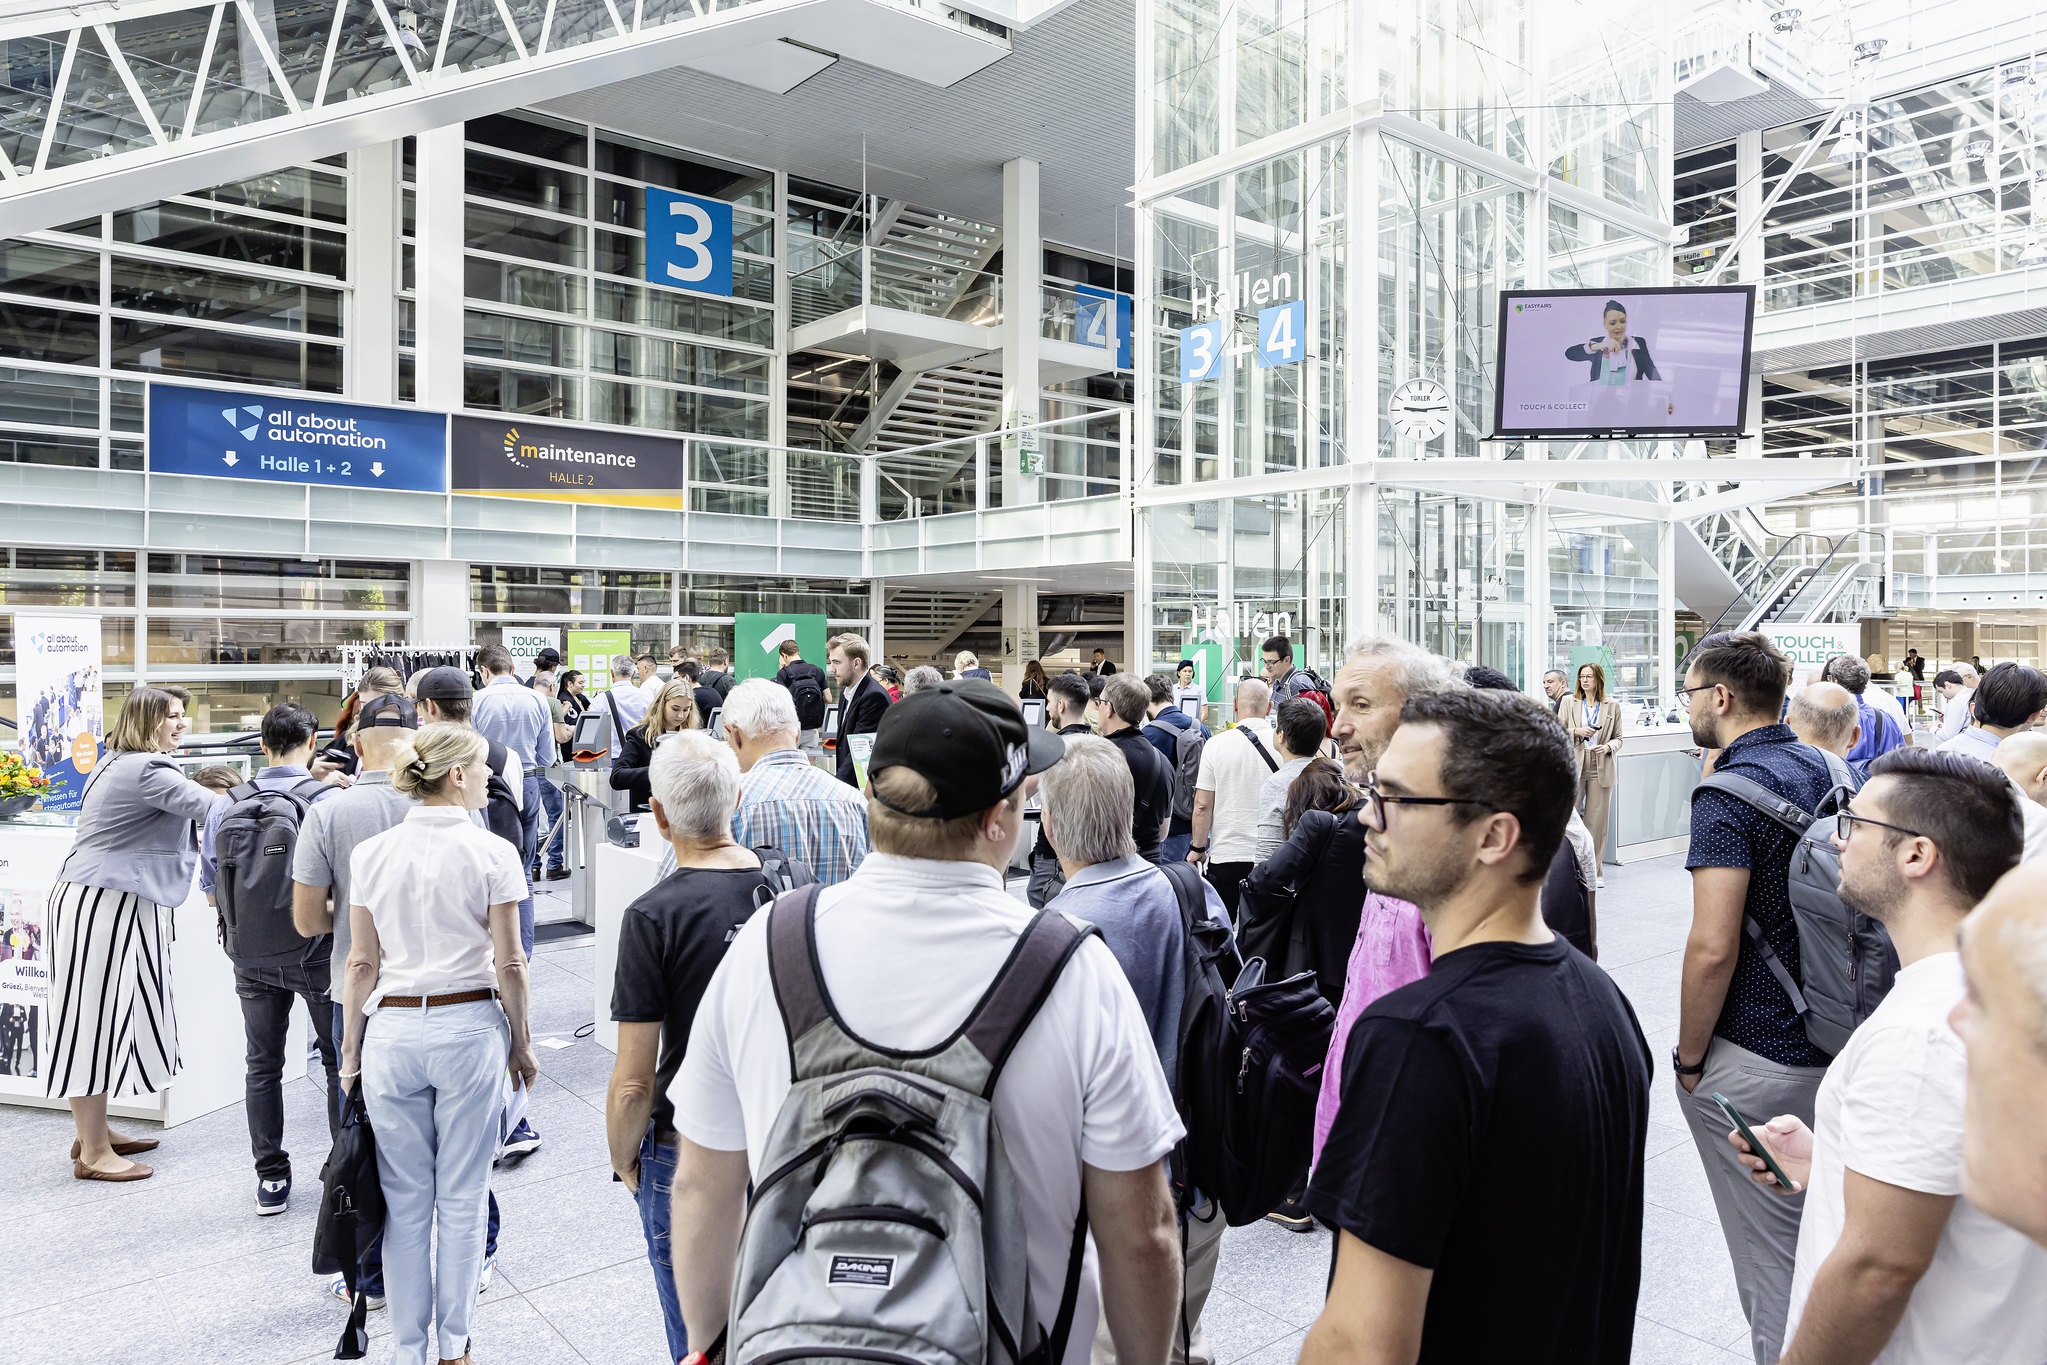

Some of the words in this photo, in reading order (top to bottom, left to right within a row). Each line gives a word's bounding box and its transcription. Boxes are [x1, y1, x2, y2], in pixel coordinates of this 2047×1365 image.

[667, 201, 713, 282] 3
[1684, 252, 1700, 261] Halle
[1192, 271, 1291, 321] Hallen
[1087, 302, 1121, 349] 4
[1189, 327, 1214, 378] 3
[1266, 307, 1297, 360] 4
[268, 410, 292, 426] all
[296, 412, 357, 432] about
[267, 427, 386, 449] automation
[520, 444, 636, 468] maintenance
[260, 455, 310, 473] Halle
[314, 459, 322, 474] 1
[326, 463, 336, 473] +
[340, 461, 352, 476] 2
[549, 471, 584, 485] HALLE
[587, 474, 594, 486] 2
[1192, 602, 1292, 638] Hallen
[47, 634, 55, 643] all
[56, 634, 78, 643] about
[511, 636, 547, 646] TOUCH
[1774, 636, 1835, 649] TOUCH
[1836, 640, 1844, 650] &
[47, 643, 89, 652] automation
[510, 647, 544, 657] COLLE
[68, 789, 78, 798] für
[15, 965, 48, 979] Willko
[2, 982, 24, 991] Grüezi,
[835, 1262, 888, 1273] DAKINE
